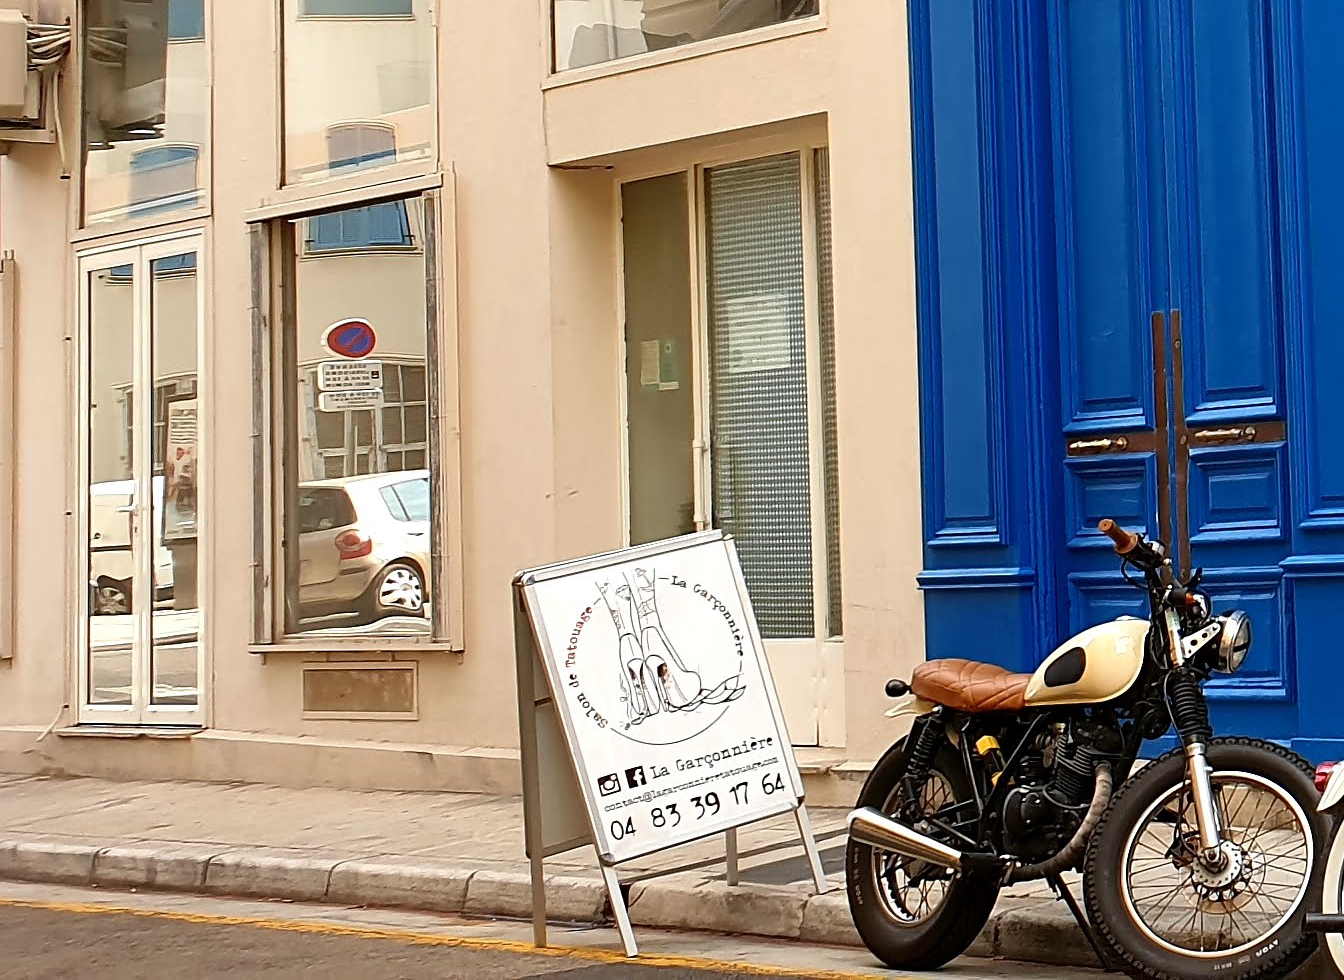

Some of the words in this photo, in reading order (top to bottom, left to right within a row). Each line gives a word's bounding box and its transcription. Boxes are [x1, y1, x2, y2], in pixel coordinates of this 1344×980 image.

[565, 606, 593, 668] Tatouage
[671, 576, 687, 588] La
[693, 584, 744, 657] Garçonnière
[568, 673, 580, 689] de
[576, 692, 609, 729] Salon
[650, 765, 670, 780] La
[675, 736, 773, 771] Garçonnière
[604, 756, 779, 812] contact@lagarconnieretatouage.com
[610, 816, 637, 840] 04
[650, 803, 681, 828] 83
[690, 791, 720, 820] 39
[728, 781, 749, 805] 17
[761, 773, 786, 795] 64
[1255, 939, 1279, 957] AVON
